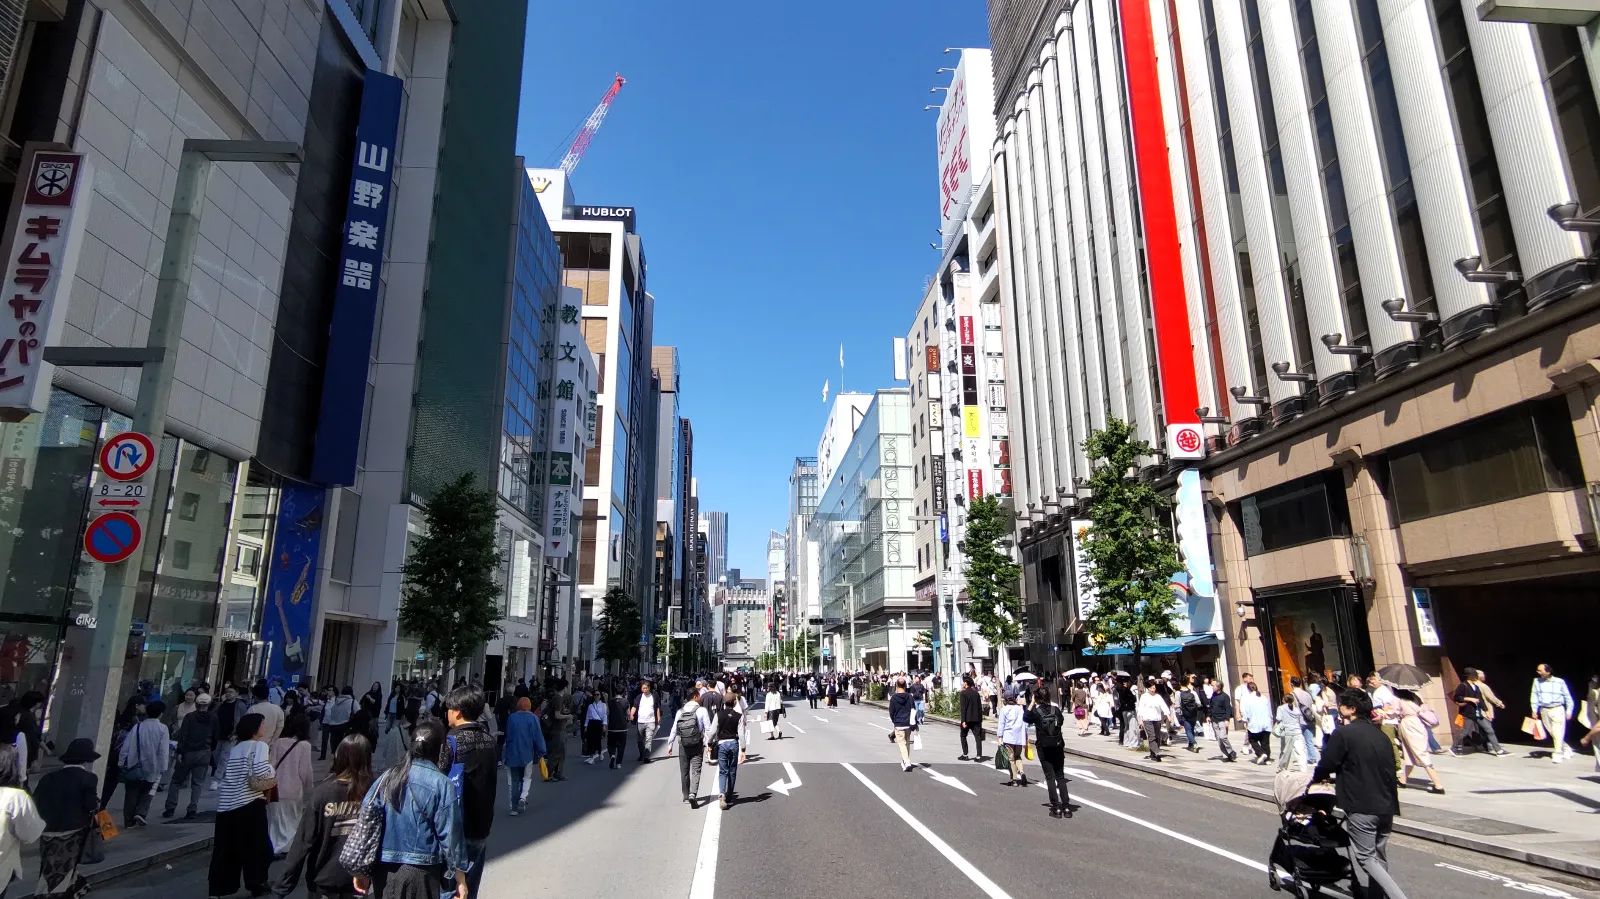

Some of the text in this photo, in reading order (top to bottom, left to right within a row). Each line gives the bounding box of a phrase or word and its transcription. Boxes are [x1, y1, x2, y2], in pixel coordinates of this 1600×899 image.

[40, 162, 72, 170] GINZA
[343, 141, 389, 291] 山野楽器
[582, 207, 632, 217] HUBLOT
[0, 215, 62, 391] キムラヤのパン
[556, 303, 579, 401] 教文館
[588, 390, 598, 441] 教文館ビル
[552, 457, 570, 480] 本
[552, 490, 565, 536] ナルニア国
